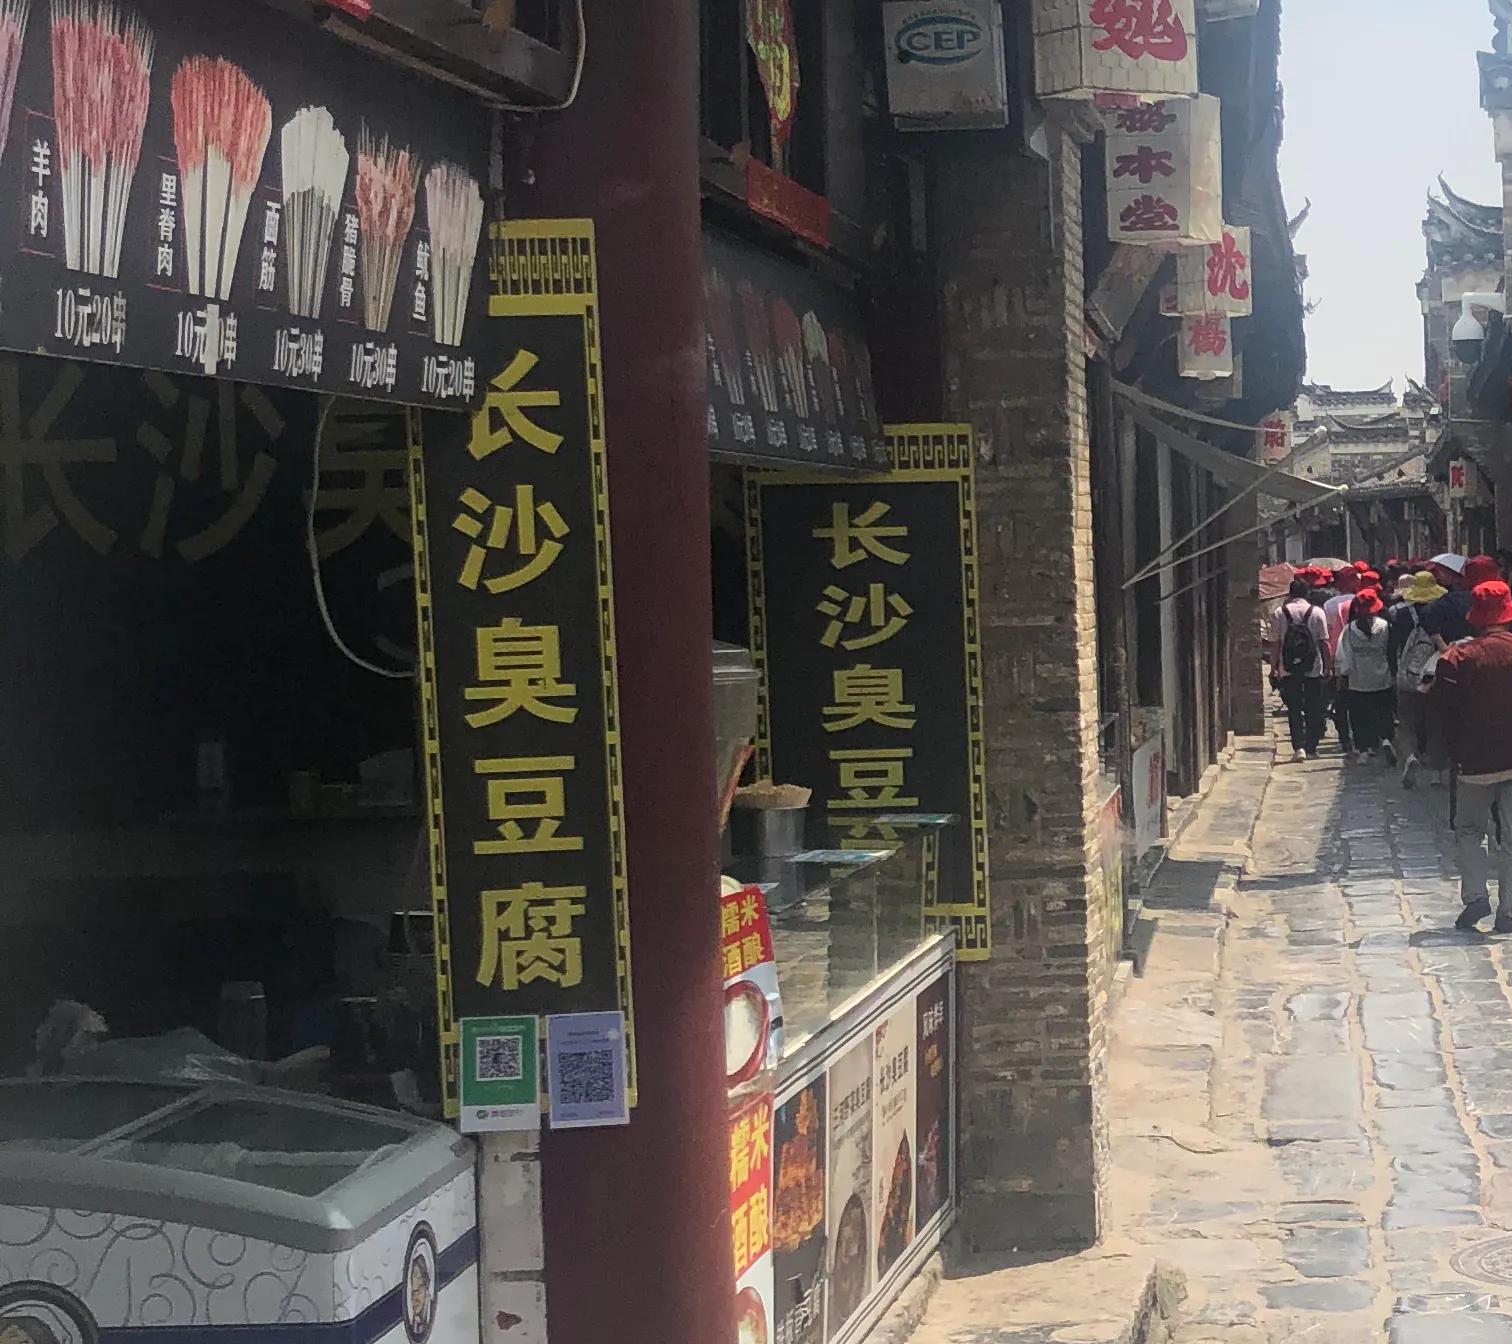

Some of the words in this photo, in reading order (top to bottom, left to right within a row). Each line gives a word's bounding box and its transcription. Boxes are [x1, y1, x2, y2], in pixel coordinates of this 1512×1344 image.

[30, 138, 51, 238] 羊肉
[156, 172, 177, 277] 里脊肉
[258, 200, 281, 292] 面筋
[412, 239, 430, 321] 鱿鱼
[54, 287, 128, 354] 10元20串
[175, 309, 238, 370] 10元0串
[272, 327, 324, 383] 10元30串
[349, 341, 398, 393] 10元30串
[421, 355, 475, 404] 10元20串
[451, 346, 588, 991] 长沙臭豆腐
